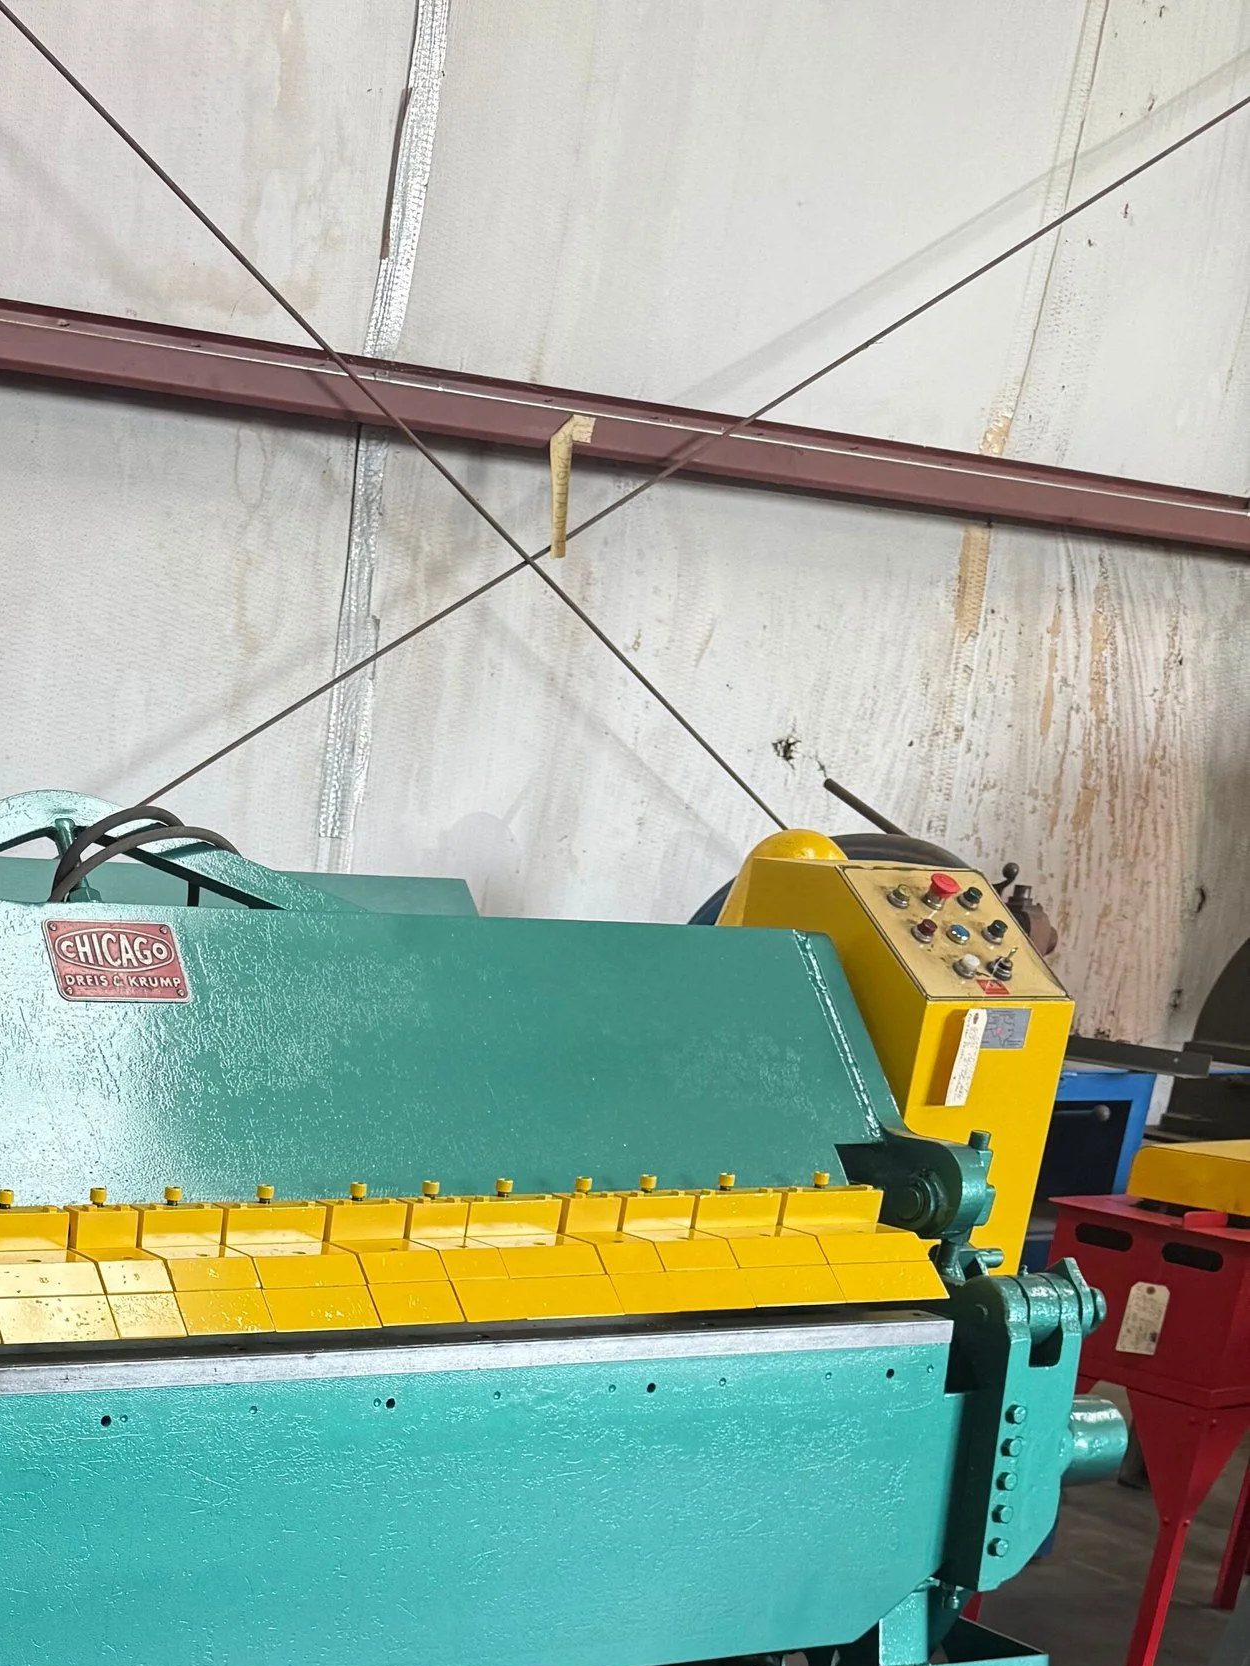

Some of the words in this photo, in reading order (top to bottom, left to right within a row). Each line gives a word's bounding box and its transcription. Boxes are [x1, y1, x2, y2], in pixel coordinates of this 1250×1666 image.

[60, 932, 168, 967] CHICAGO
[65, 975, 109, 987] DREIS
[128, 976, 181, 988] KRUMP
